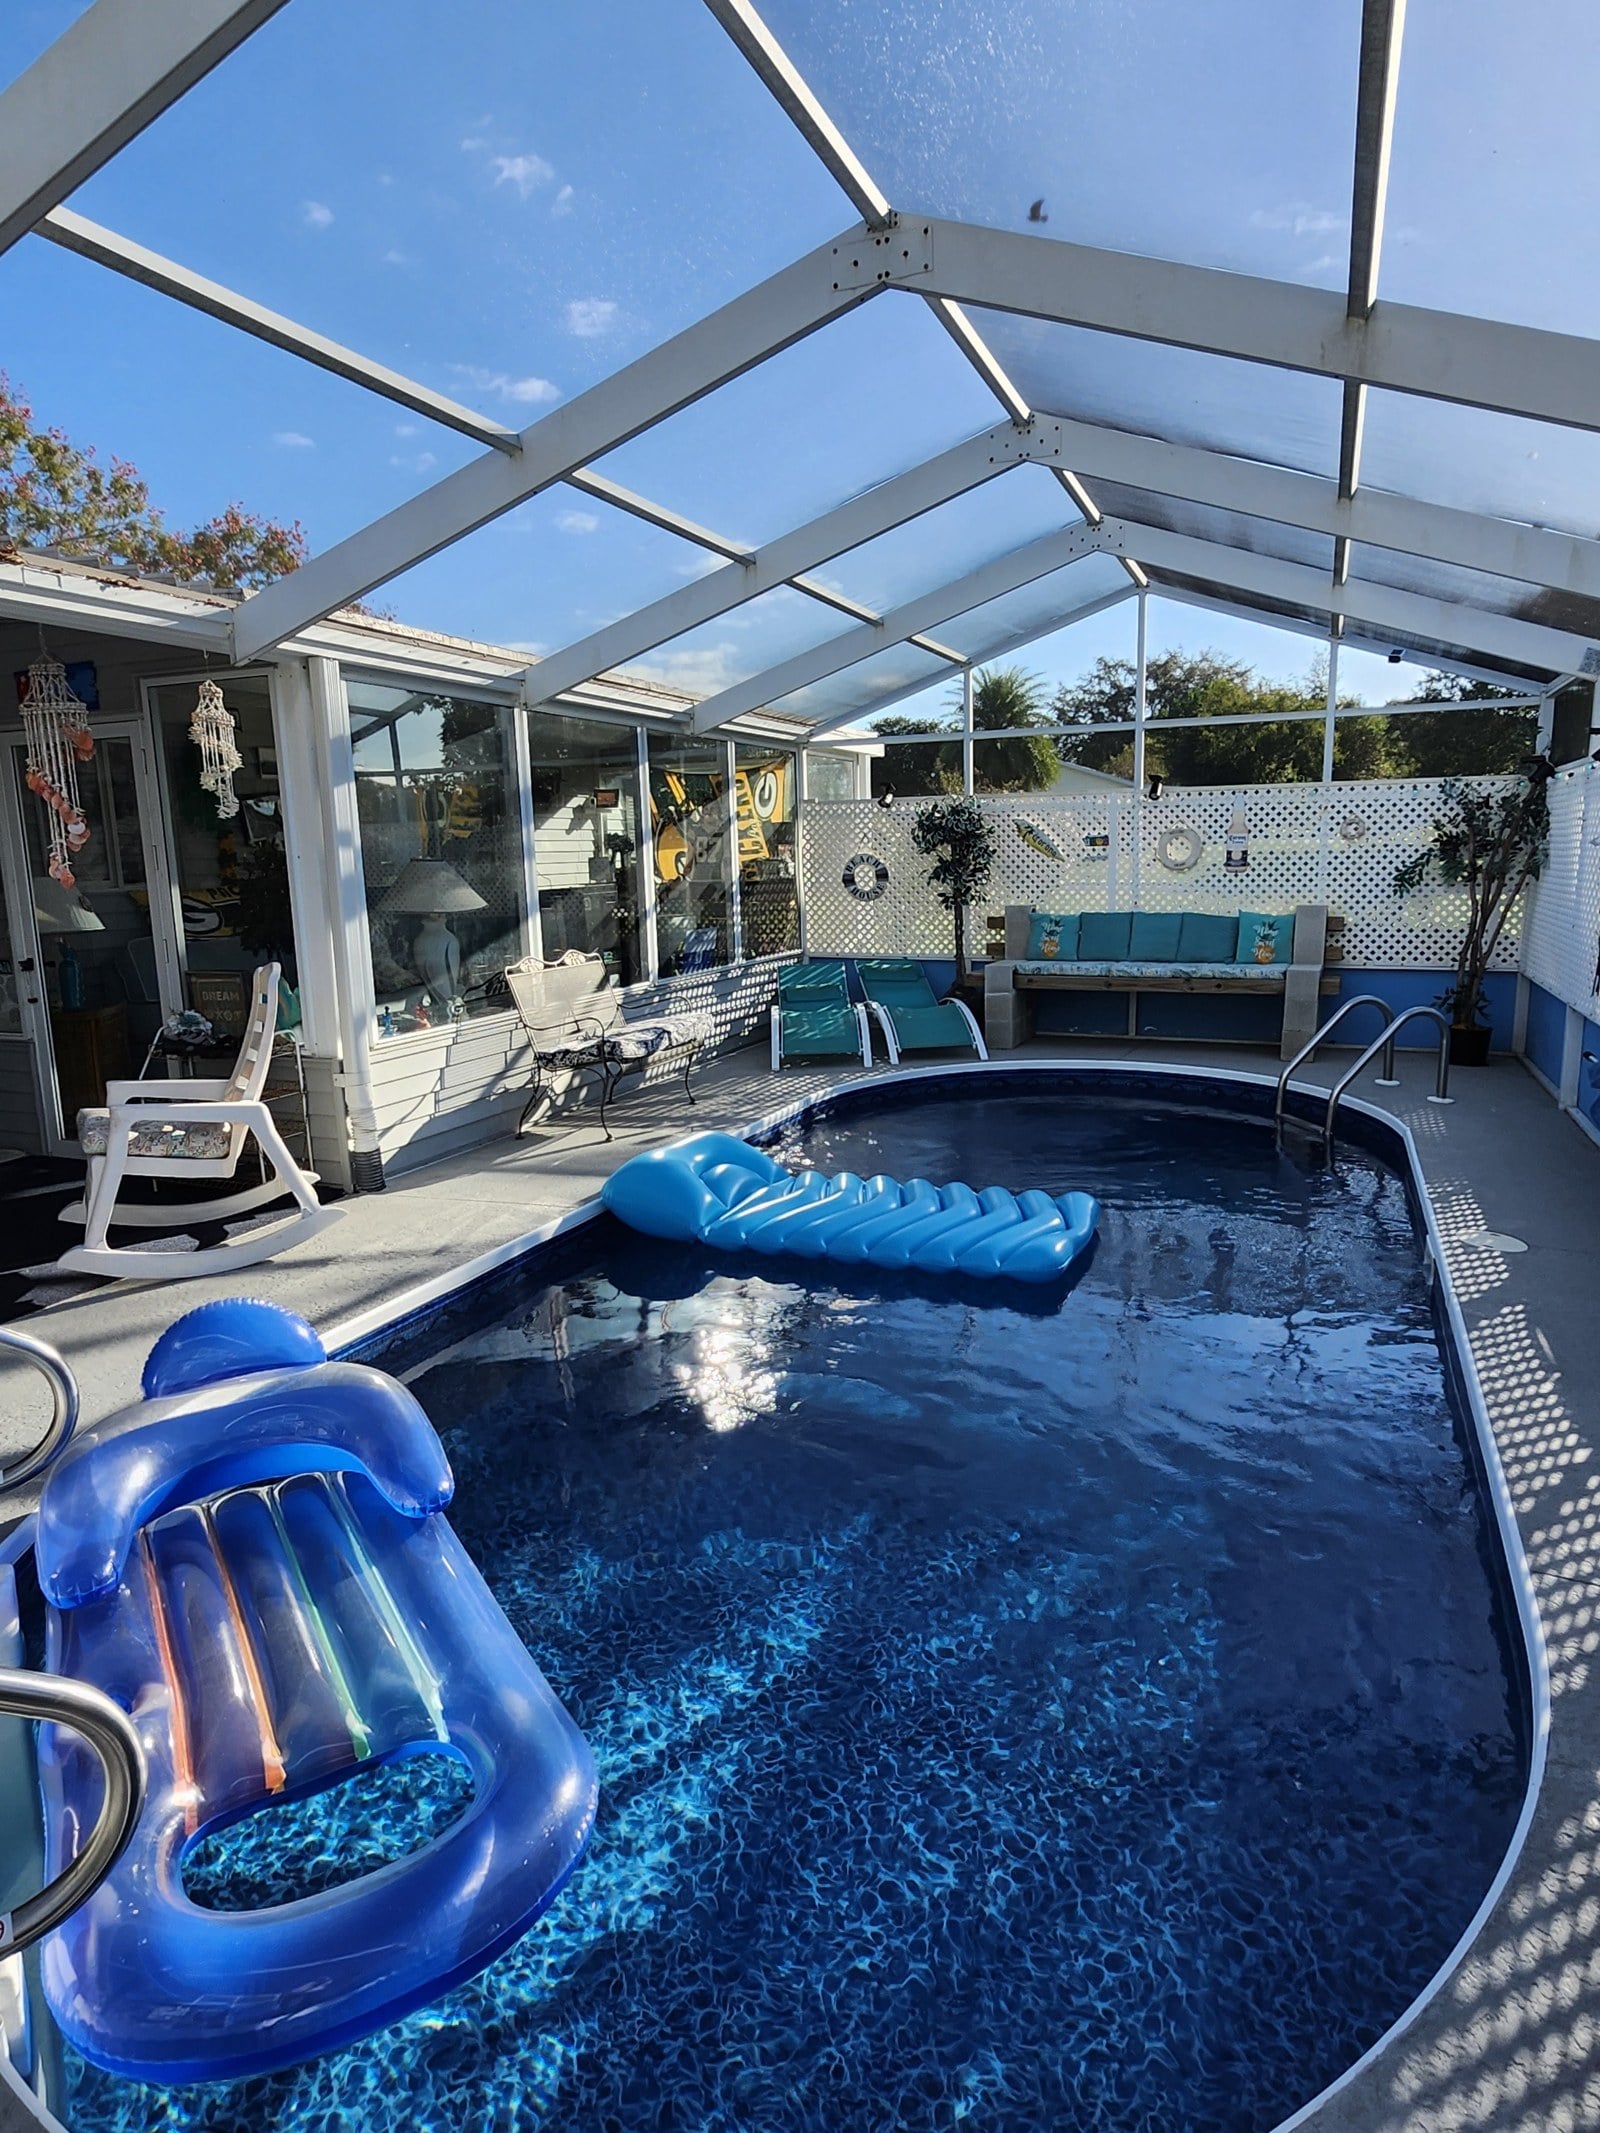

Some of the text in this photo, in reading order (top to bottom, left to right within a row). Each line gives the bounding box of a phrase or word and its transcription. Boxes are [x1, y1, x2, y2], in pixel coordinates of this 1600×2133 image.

[845, 854, 881, 872] BEACH
[851, 882, 887, 900] HOUSE
[202, 991, 240, 1001] DREAM
